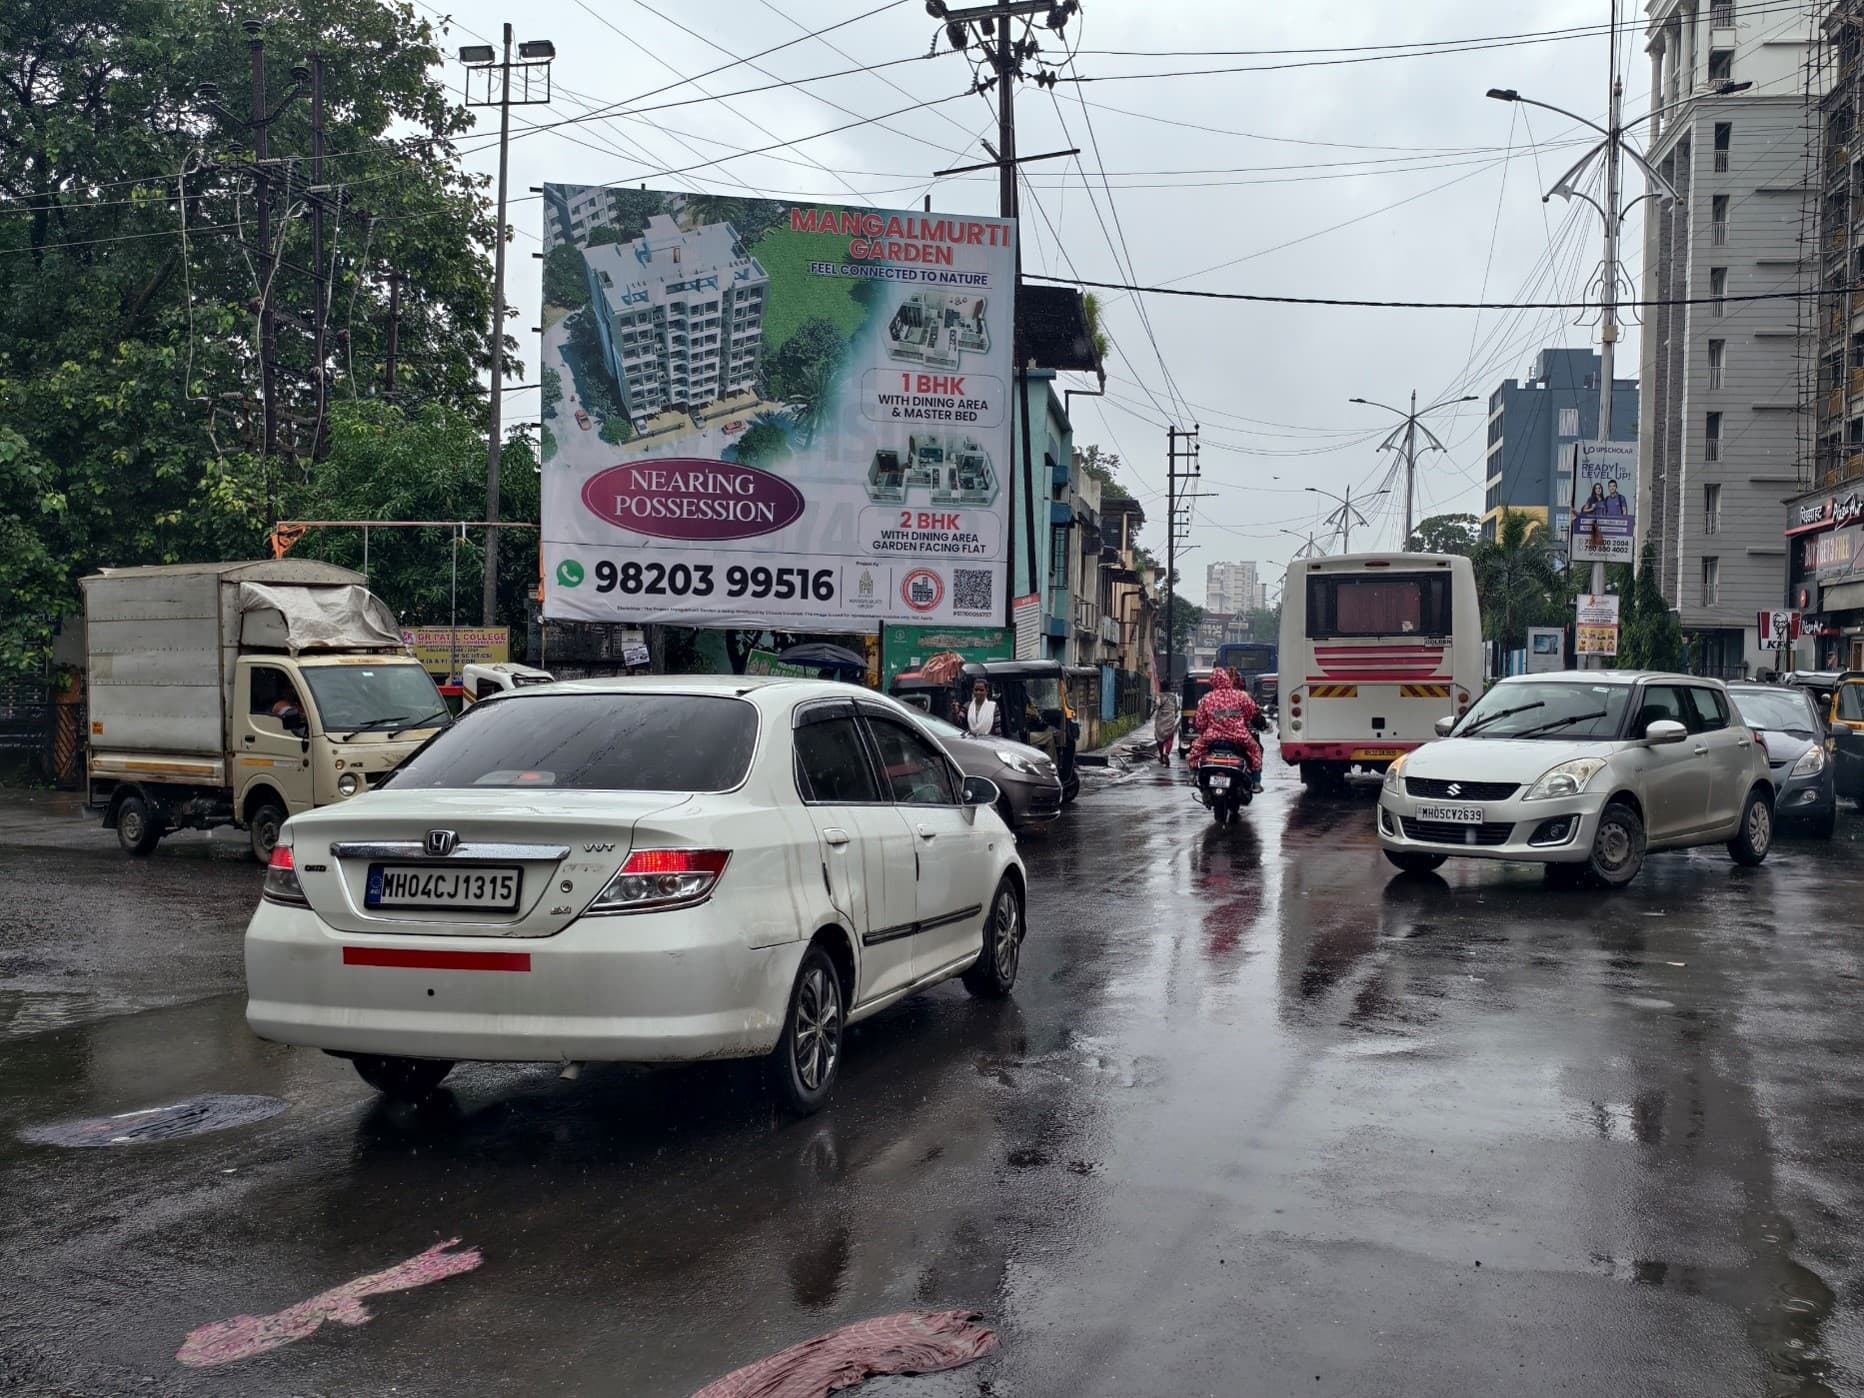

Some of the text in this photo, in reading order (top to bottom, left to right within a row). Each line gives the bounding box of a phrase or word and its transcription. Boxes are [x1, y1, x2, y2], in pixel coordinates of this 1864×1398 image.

[790, 208, 1009, 247] MANGALMURTI
[849, 239, 954, 265] GARDEN
[811, 262, 988, 286] FEEL CONNECTED TO NATURE
[902, 373, 966, 395] 1 BHK
[878, 394, 989, 411] WITH DINING AREA
[892, 407, 978, 422] & MASTER BED
[1582, 463, 1615, 472] READY
[1582, 471, 1612, 479] LEVEL
[630, 469, 756, 496] NEARING
[614, 495, 776, 523] POSSESSION
[900, 511, 961, 530] 2 BHK
[881, 530, 979, 543] WITH DINING AREA
[872, 540, 987, 554] GARDEN FACING FLAT
[594, 559, 835, 602] 98203 99516
[434, 633, 461, 641] PATL
[463, 633, 507, 641] COLLEGE
[383, 871, 513, 903] MH04CJ1315
